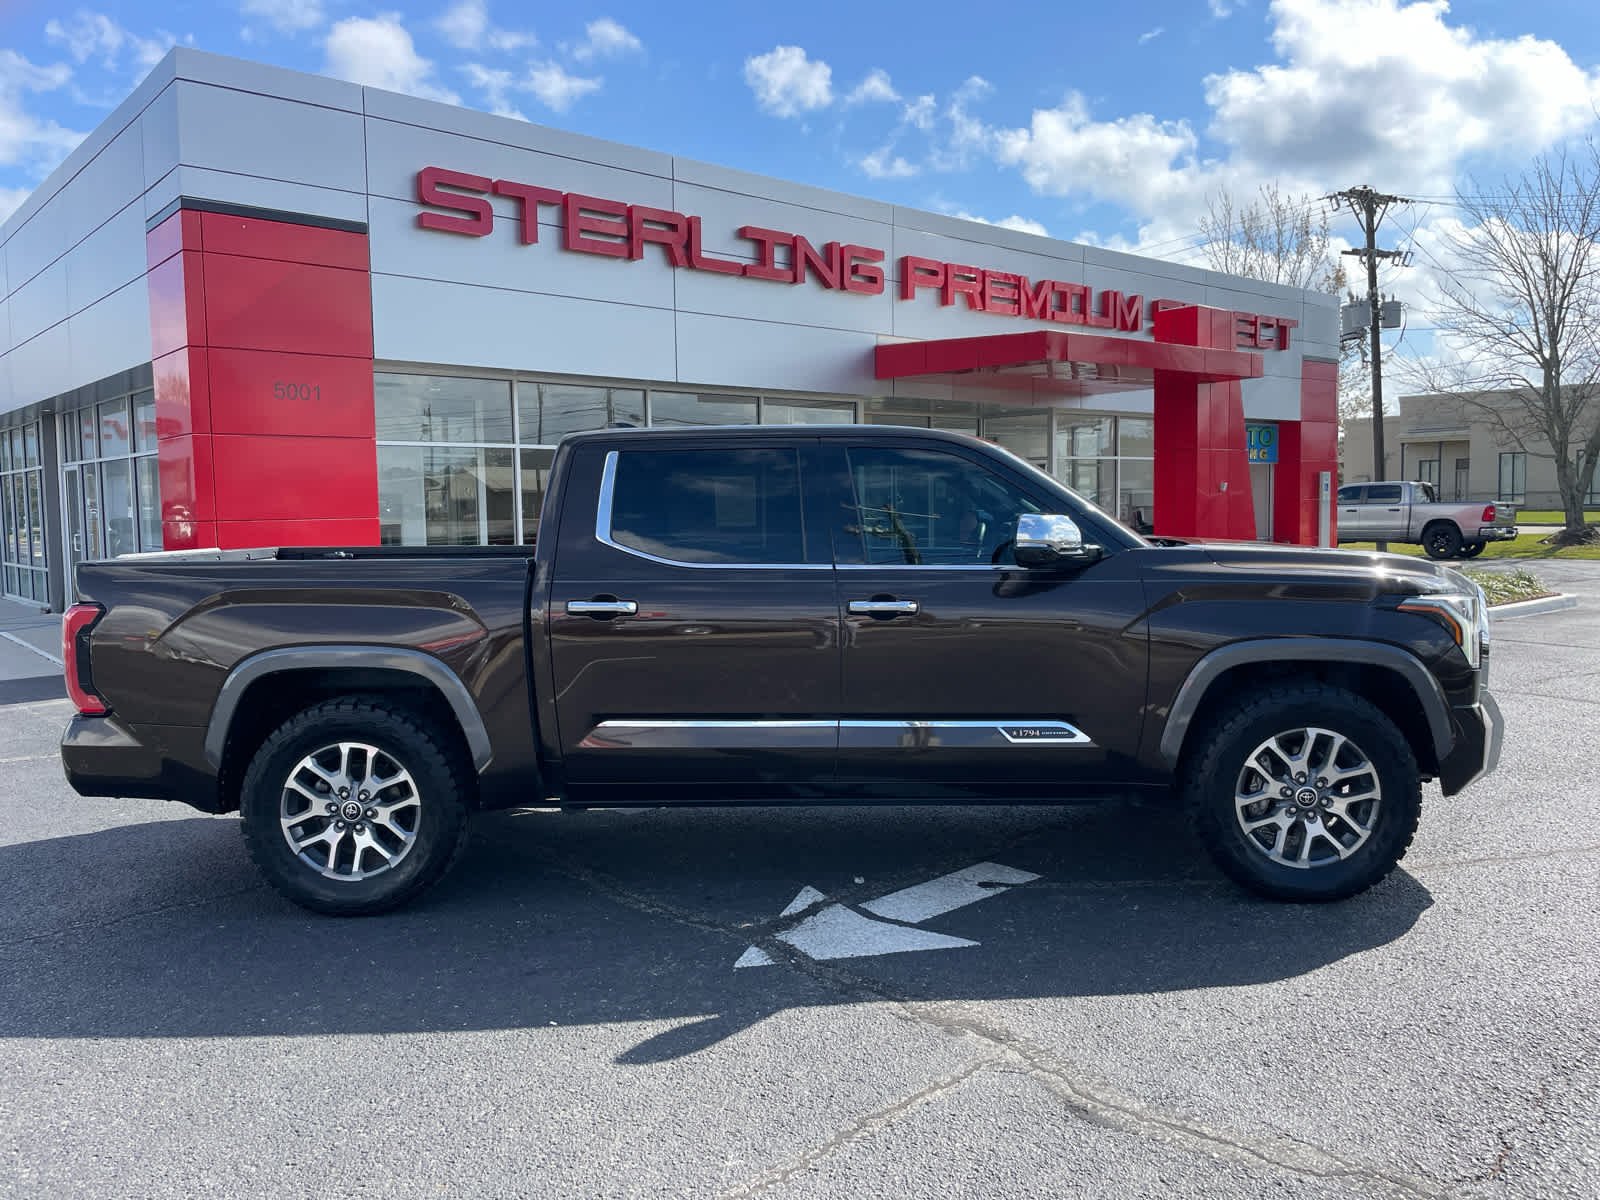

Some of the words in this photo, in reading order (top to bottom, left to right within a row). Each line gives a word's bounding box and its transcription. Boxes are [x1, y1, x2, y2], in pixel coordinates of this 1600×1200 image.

[417, 166, 885, 296] STERLING
[900, 256, 1144, 331] PREMIUM
[1152, 299, 1298, 350] ECT
[273, 380, 321, 401] 5001
[1019, 729, 1040, 737] 1794
